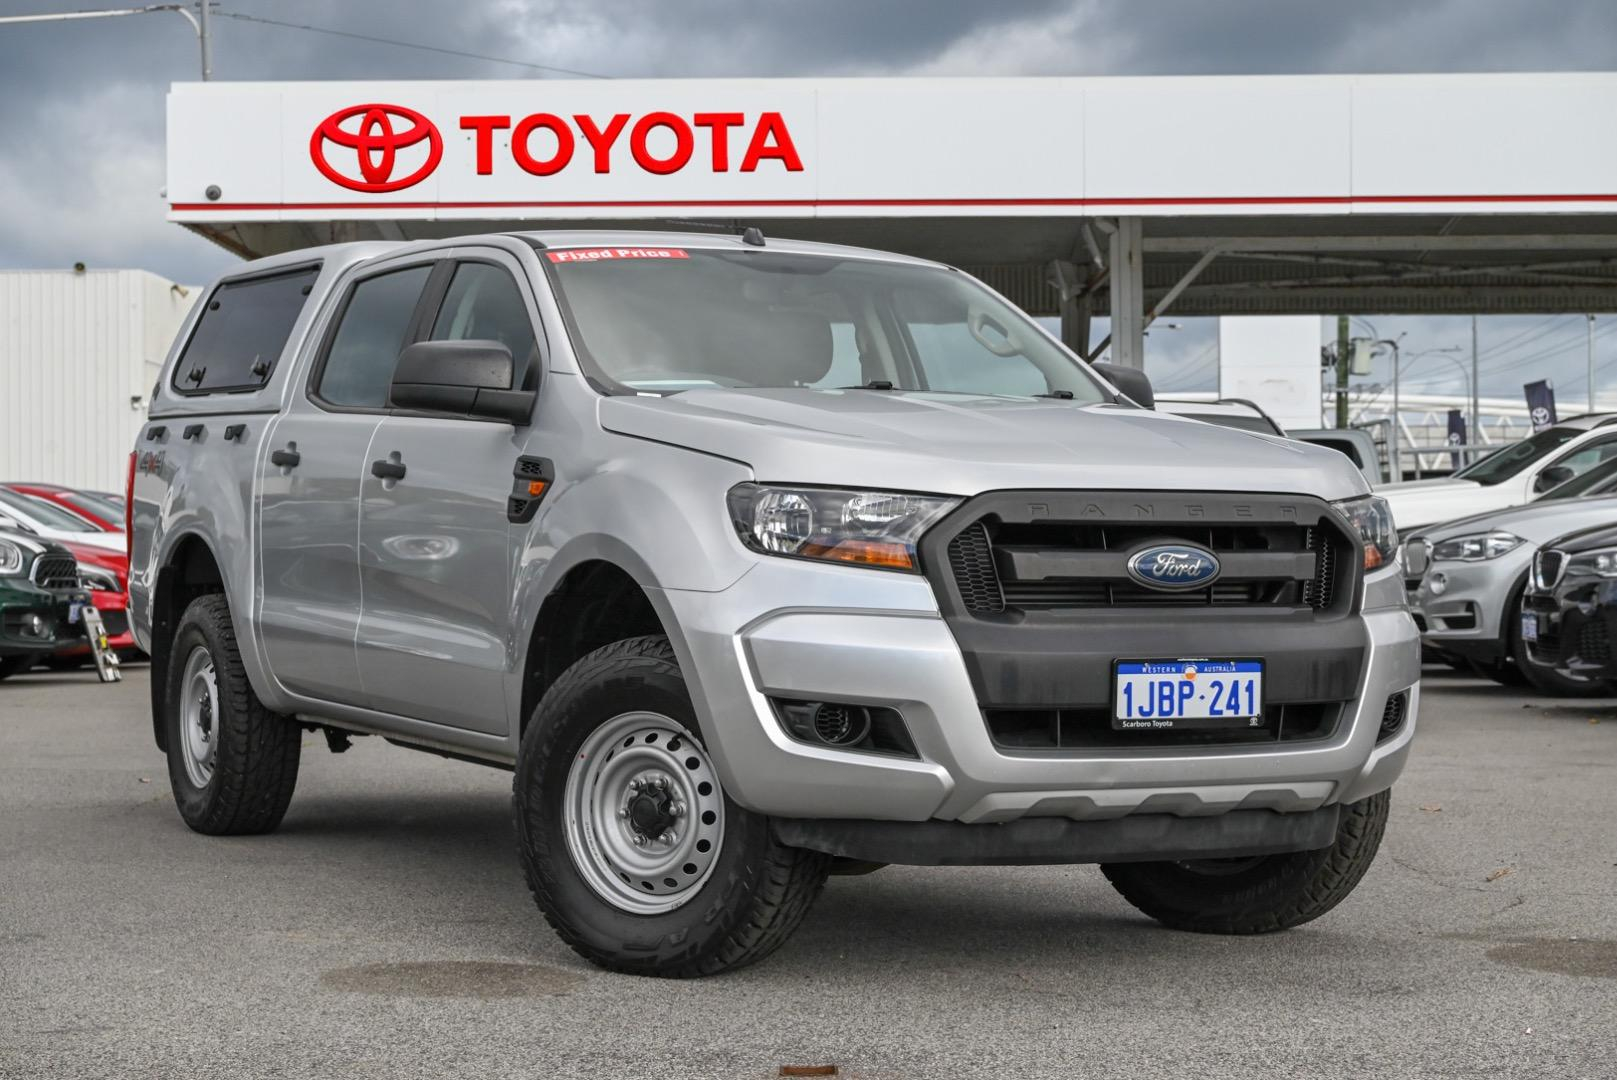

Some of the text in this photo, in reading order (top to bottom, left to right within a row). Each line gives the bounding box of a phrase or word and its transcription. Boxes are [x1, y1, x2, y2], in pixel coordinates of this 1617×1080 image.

[460, 112, 804, 176] TOYOTA
[556, 250, 613, 261] Fixed
[615, 249, 671, 257] Price
[1028, 503, 1298, 517] RANGER
[1152, 552, 1204, 577] Ford
[1152, 720, 1173, 728] Toyota
